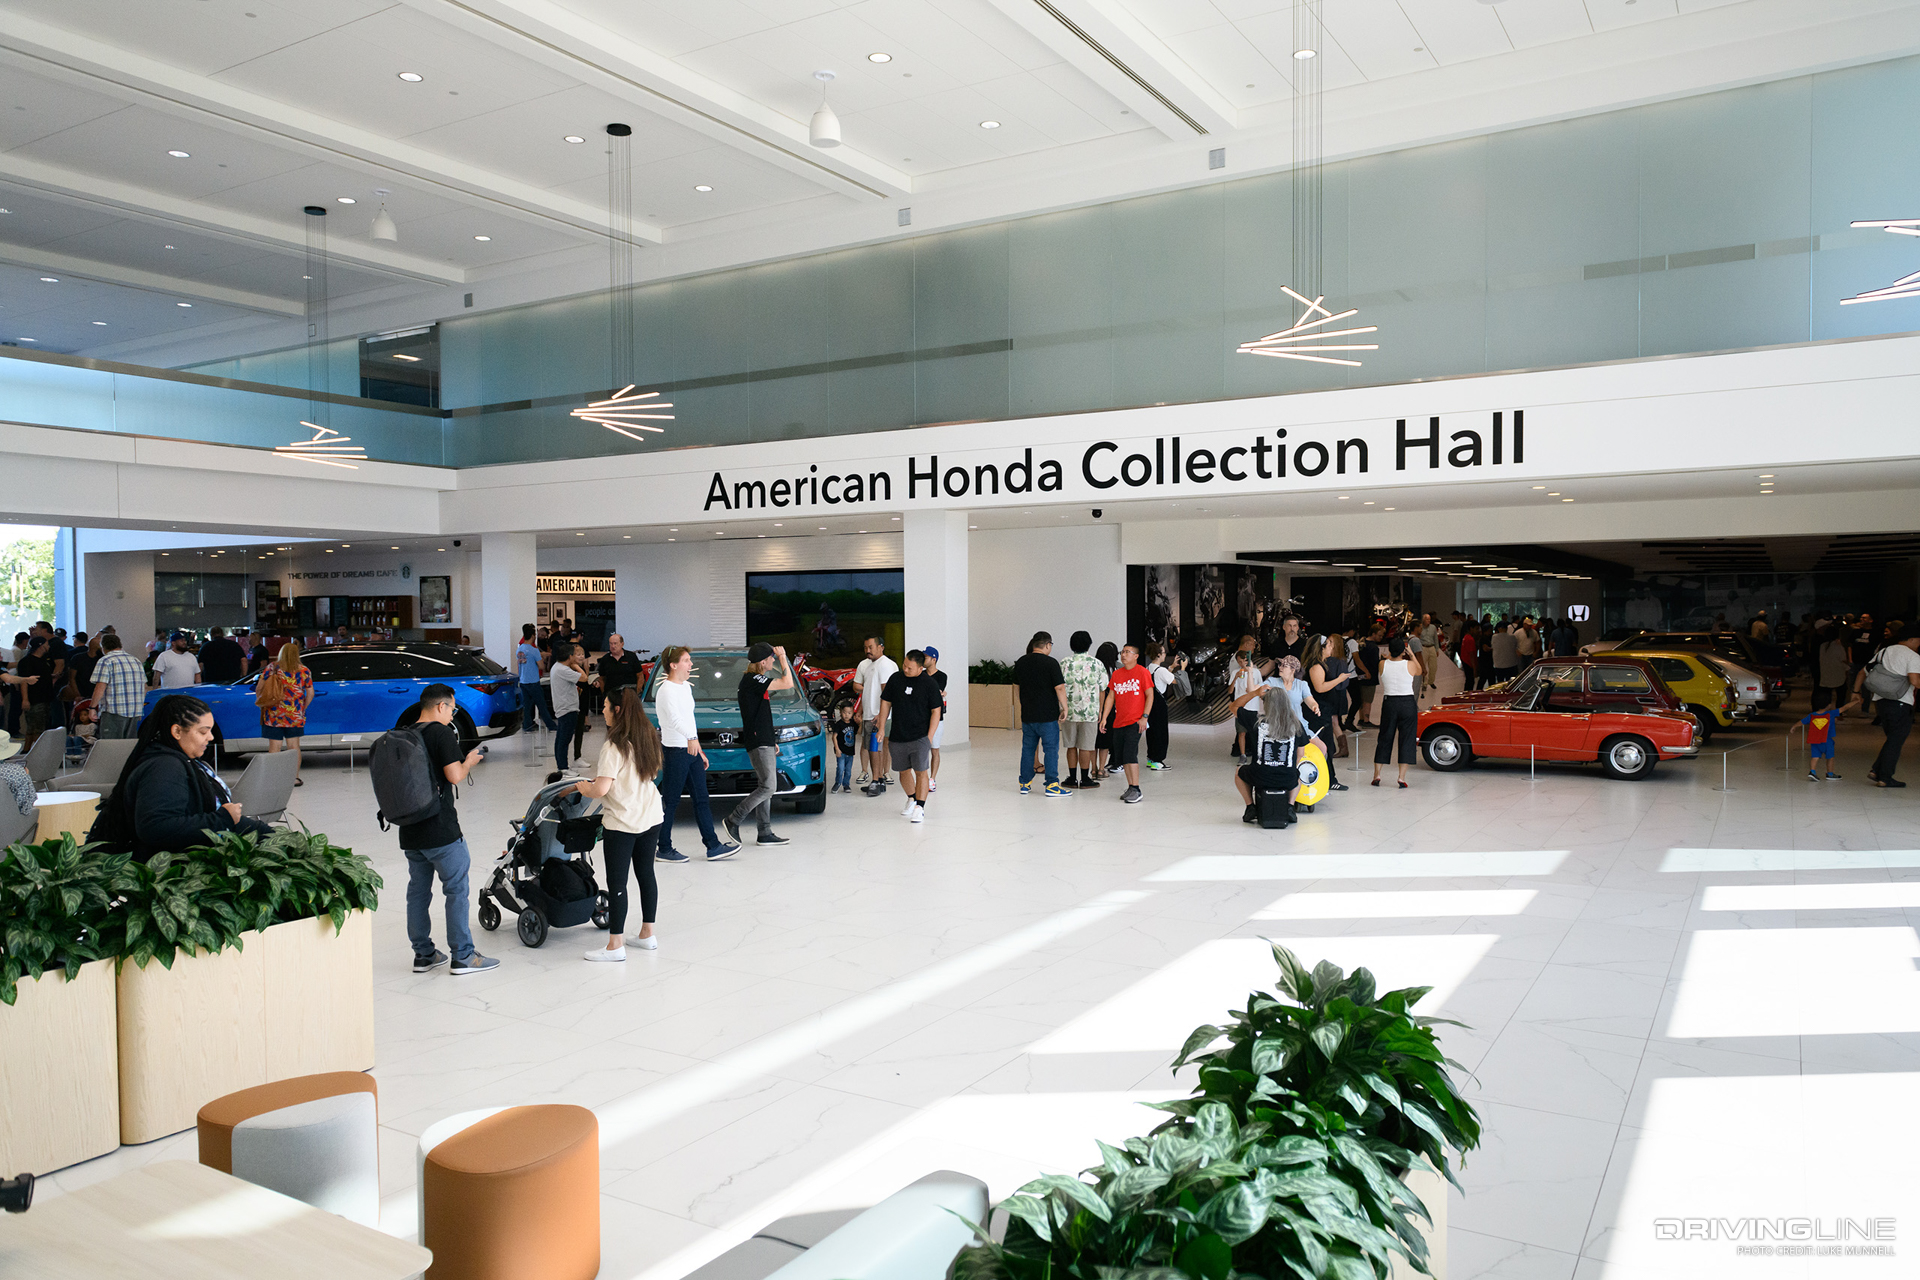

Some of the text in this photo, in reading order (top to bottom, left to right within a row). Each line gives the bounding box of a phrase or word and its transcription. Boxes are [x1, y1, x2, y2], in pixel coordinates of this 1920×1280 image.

[703, 409, 1524, 512] American Honda Collection Hall
[288, 569, 398, 580] THE POWER OF DREAMS CAFE
[536, 578, 616, 593] AMERICAN HOND
[585, 606, 606, 617] people
